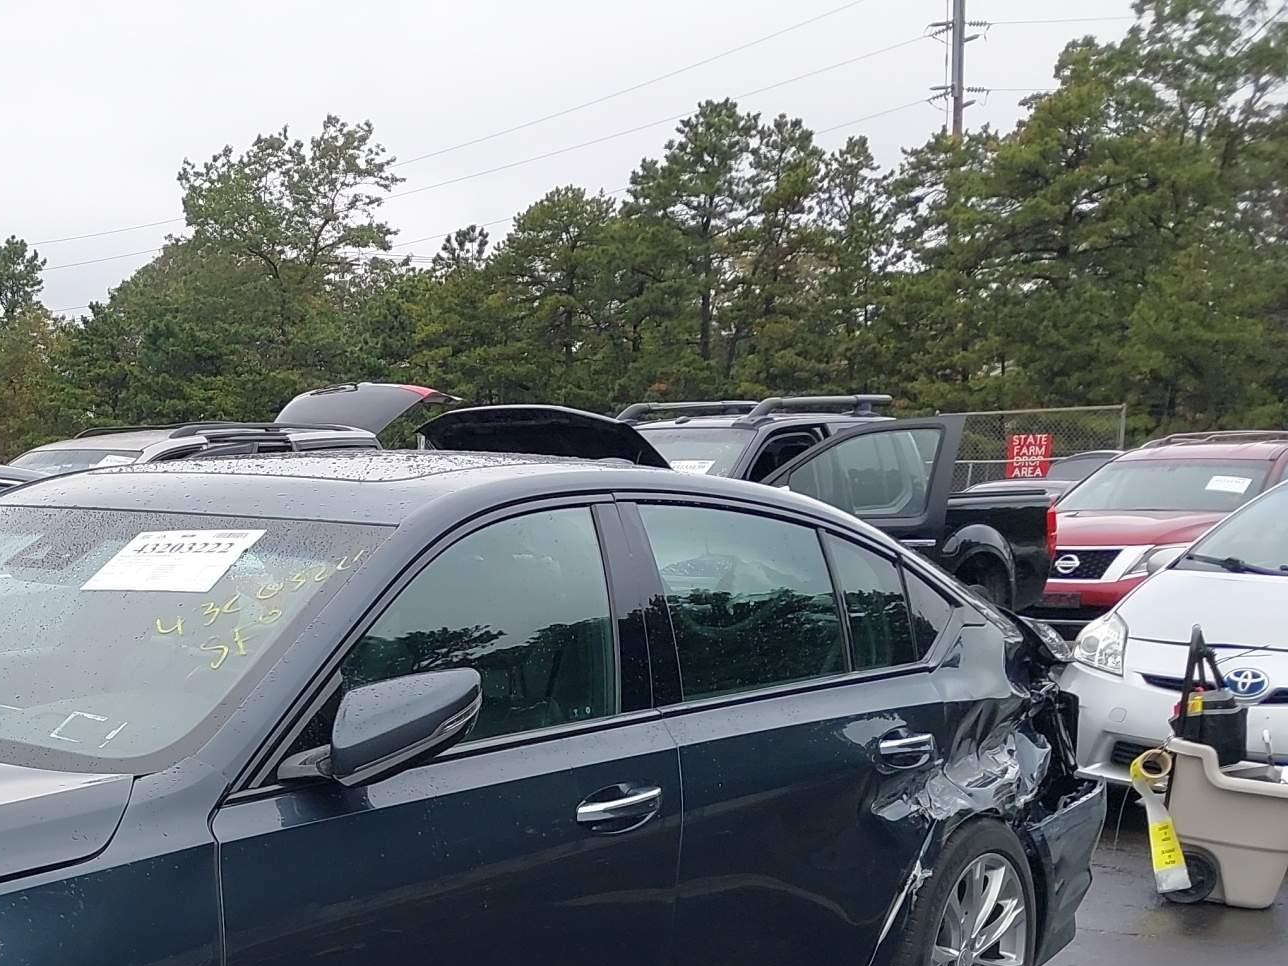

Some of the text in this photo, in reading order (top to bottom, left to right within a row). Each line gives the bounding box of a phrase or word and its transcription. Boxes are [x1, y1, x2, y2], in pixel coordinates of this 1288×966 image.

[1012, 434, 1048, 446] STATE
[1013, 445, 1046, 456] FARM
[1013, 456, 1044, 467] DROP
[1012, 466, 1043, 477] AREA
[133, 542, 235, 554] 43203222
